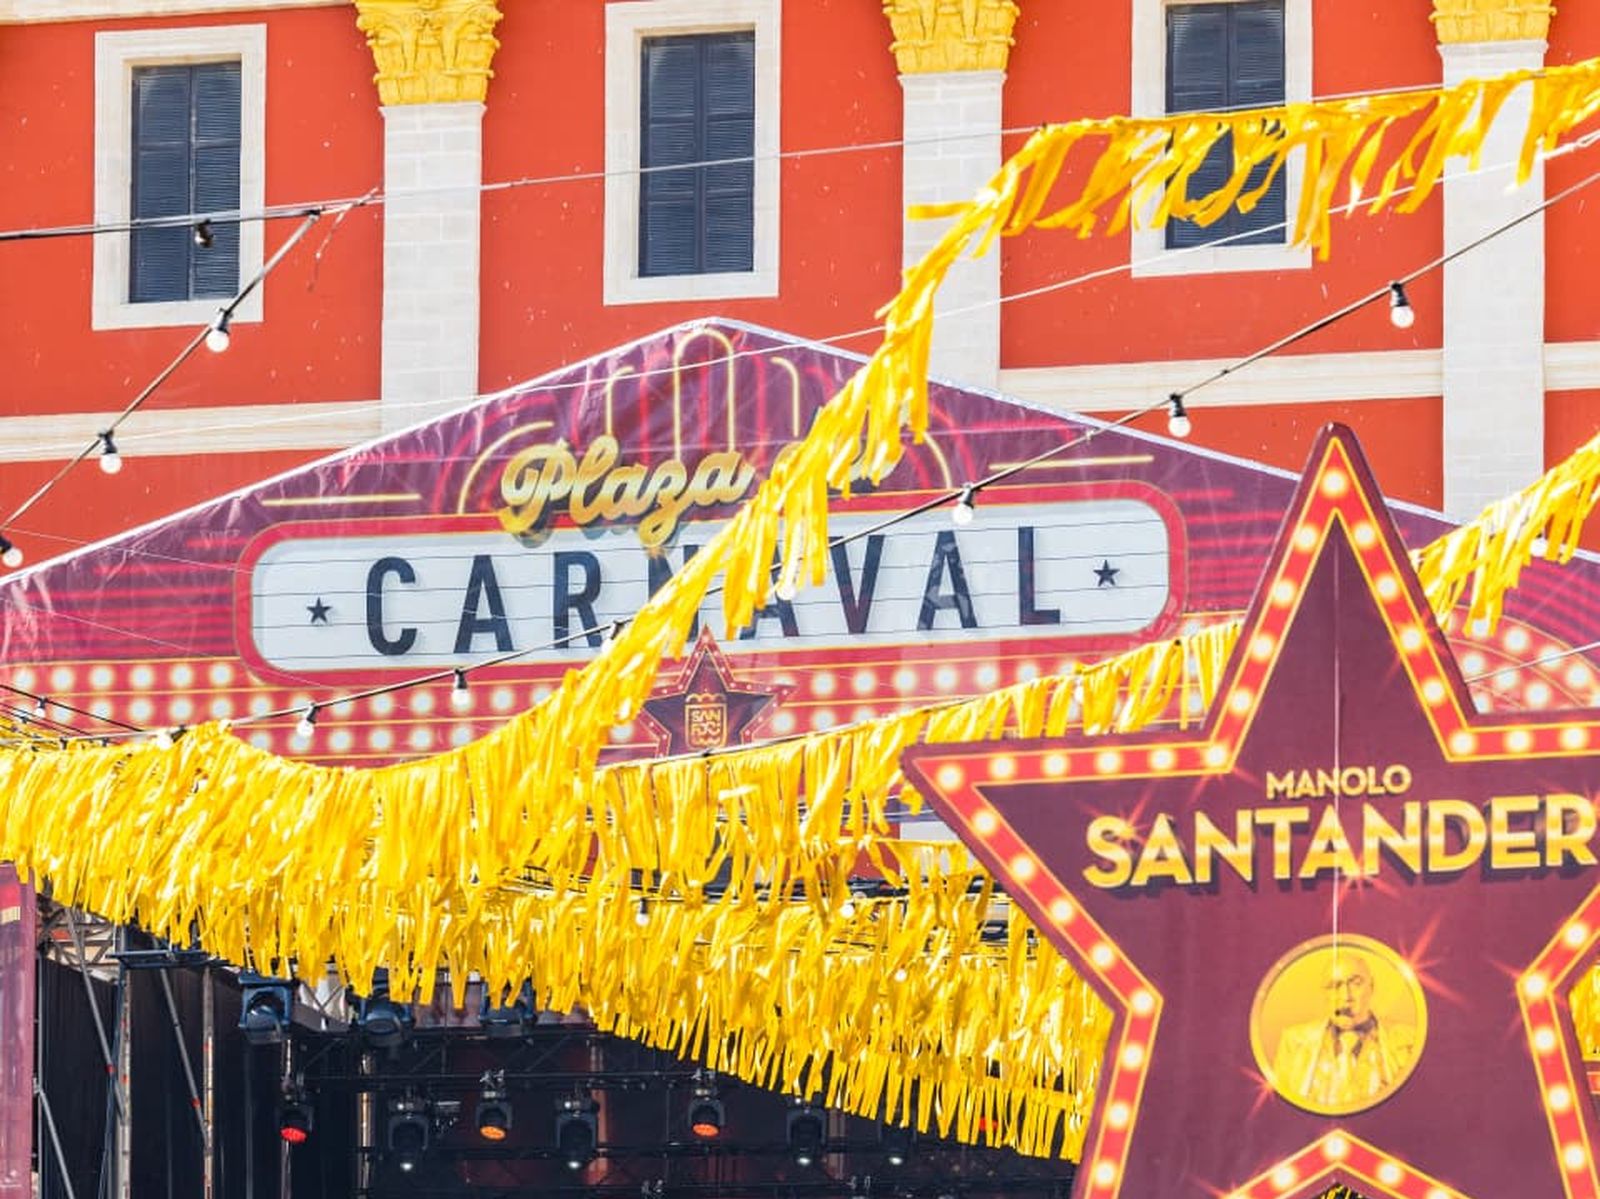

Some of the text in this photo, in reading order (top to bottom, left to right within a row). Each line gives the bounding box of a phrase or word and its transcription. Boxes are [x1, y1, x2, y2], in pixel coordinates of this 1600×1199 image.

[497, 433, 756, 548] Plaza
[691, 710, 720, 721] SAN
[1266, 764, 1412, 799] MANOLO
[1082, 793, 1599, 889] SANTANDER
